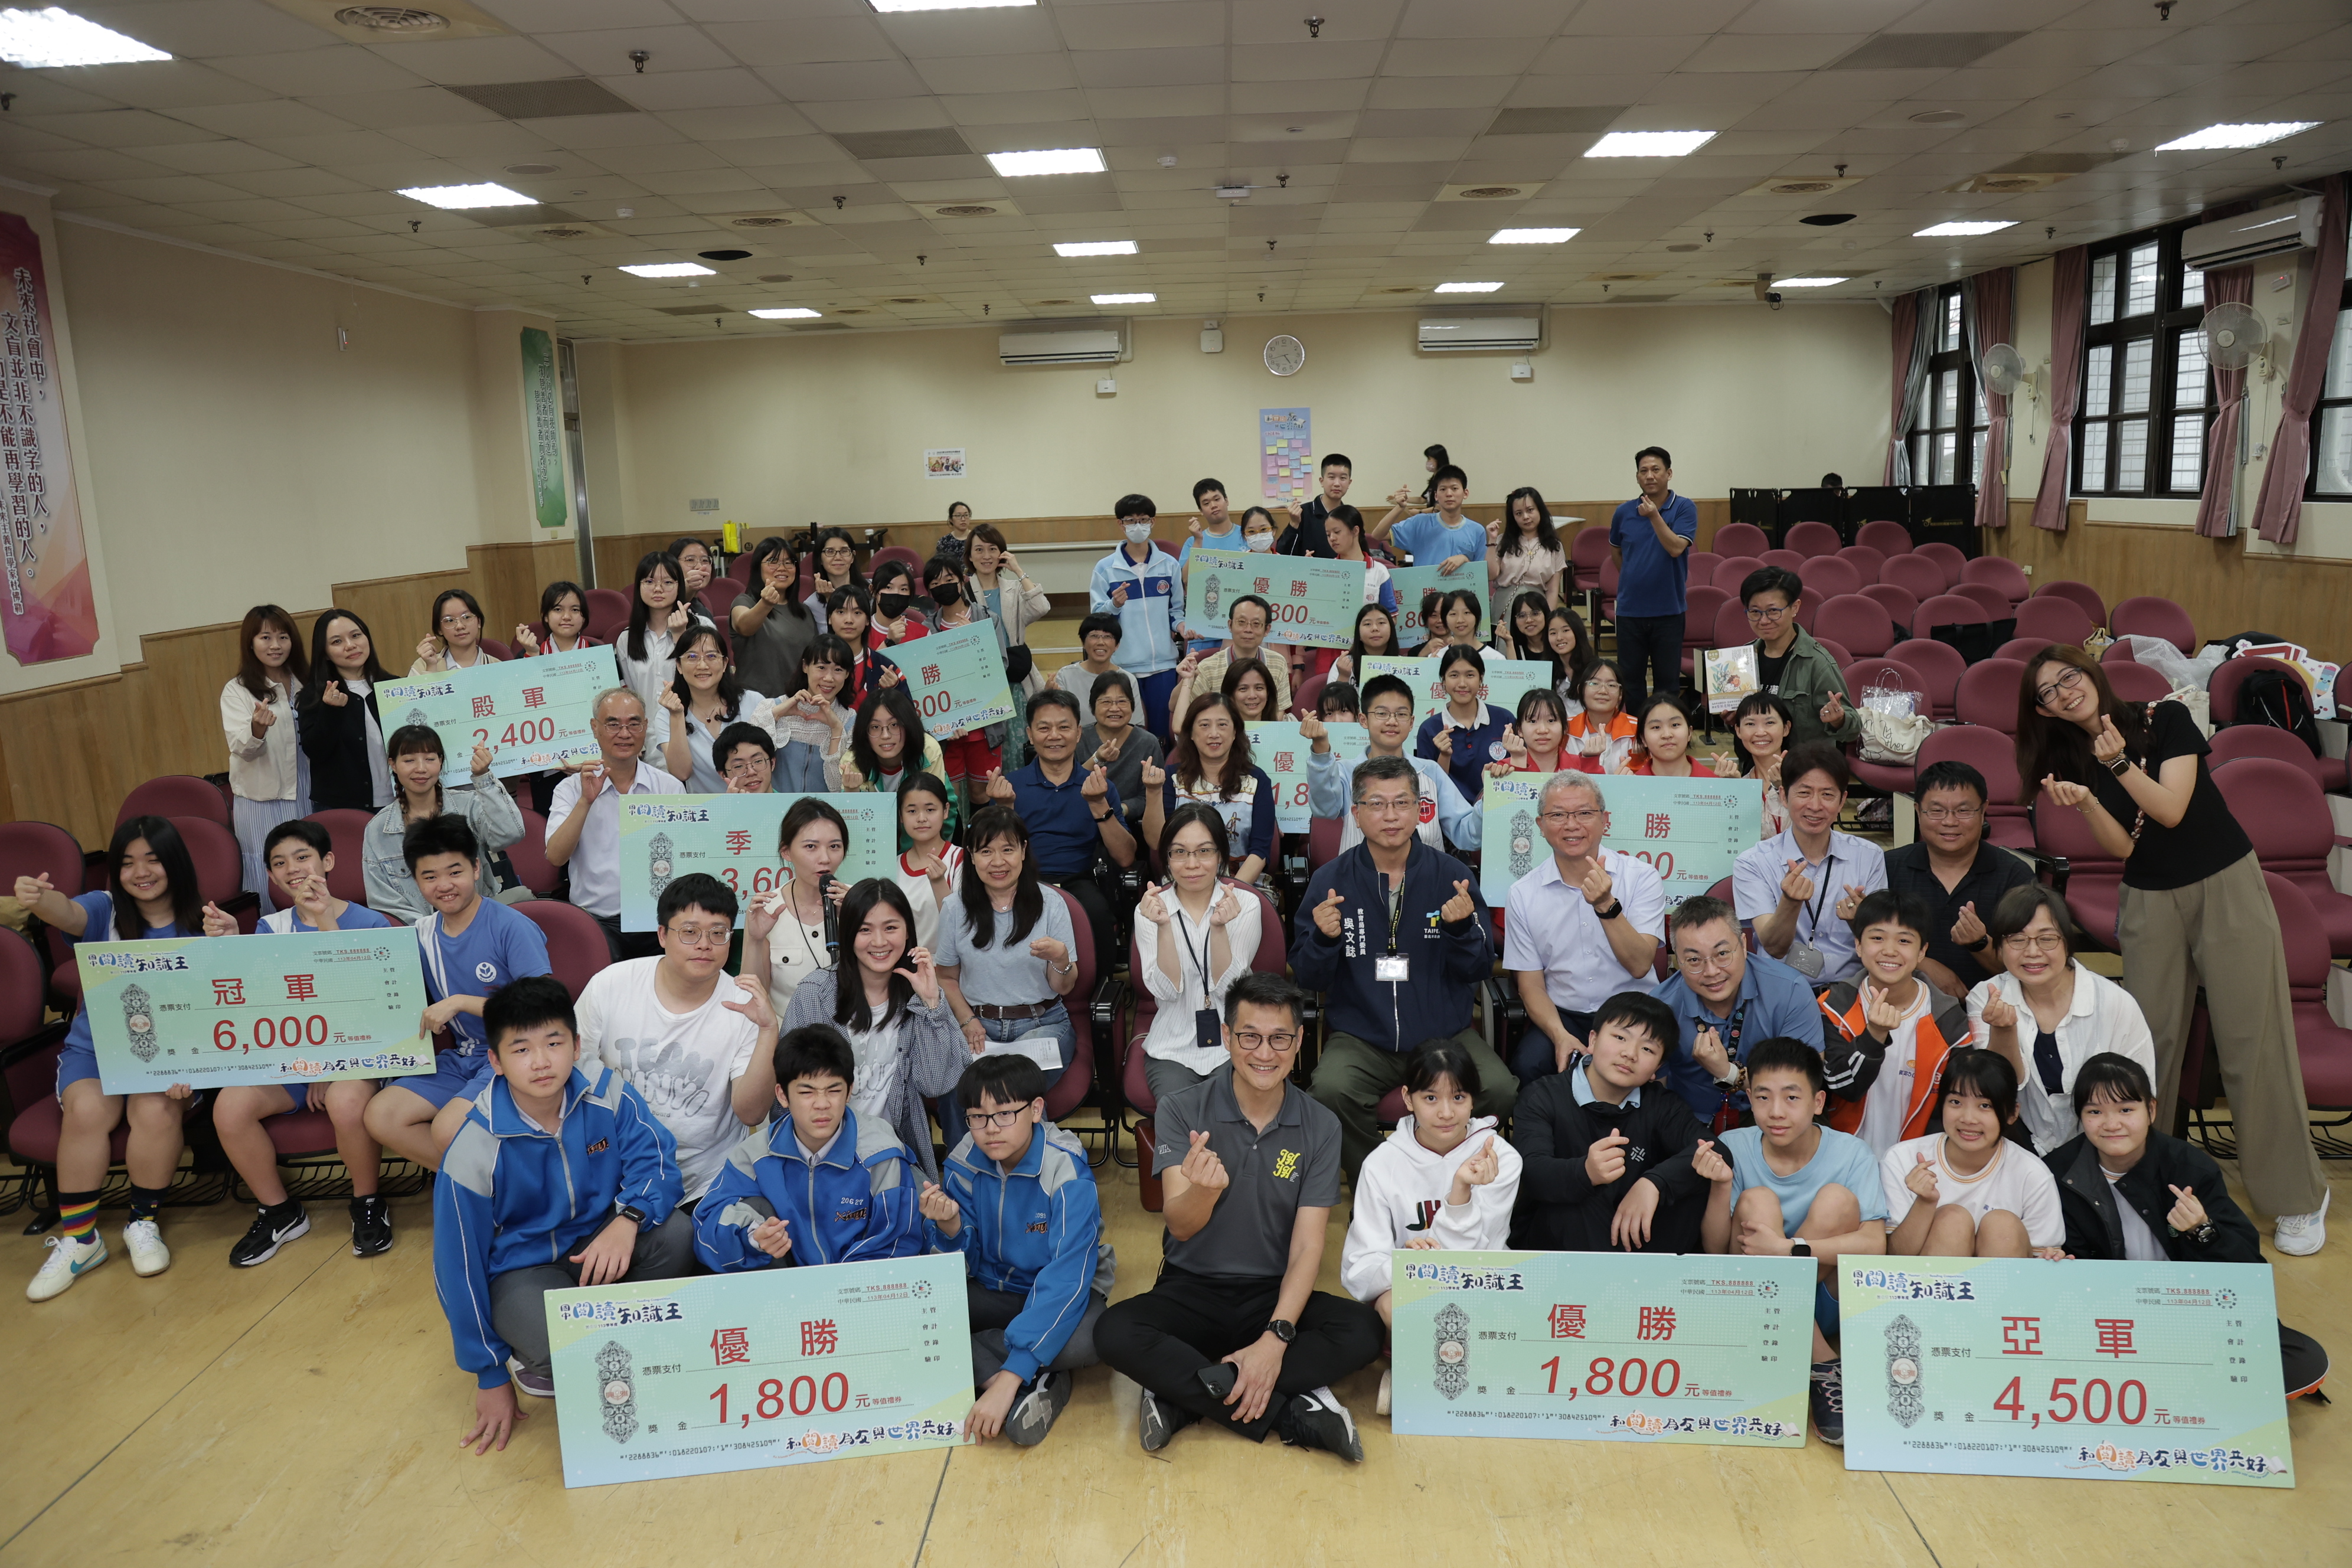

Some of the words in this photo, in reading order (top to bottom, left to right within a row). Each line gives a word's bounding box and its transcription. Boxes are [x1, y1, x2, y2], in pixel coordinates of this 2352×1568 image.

[14, 267, 45, 400] 未來社會中，
[1, 312, 48, 533] 文盲並非不識字的人，
[1253, 576, 1308, 597] 優勝
[1269, 602, 1308, 624] 800
[920, 662, 943, 687] 勝
[390, 678, 455, 704] 閱讀知識王
[470, 686, 547, 718] 殿軍
[953, 699, 962, 708] 元
[469, 717, 557, 757] 2,400
[558, 729, 568, 738] 元
[520, 741, 600, 768] 和閱讀為友與世界
[1272, 782, 1309, 809] 1,8
[1500, 780, 1540, 801] 閱讀知
[636, 803, 710, 823] 閱讀知識王
[726, 829, 752, 855] 季
[720, 867, 793, 900] 3,60
[1676, 870, 1687, 880] 元
[1344, 917, 1357, 958] 吳文誌
[1357, 907, 1366, 955] 教育局專門委員
[211, 973, 319, 1006] 冠軍
[158, 1002, 192, 1012] 憑票支付
[210, 1014, 331, 1056] 6,000
[332, 1032, 347, 1043] 元
[278, 1051, 417, 1076] 和閱讀為友與世界共好
[615, 1038, 714, 1090] TEAM
[837, 1286, 861, 1295] 支票號碼
[865, 1282, 908, 1292] TKS.888888
[1406, 1263, 1415, 1278] 國中
[1417, 1263, 1525, 1291] 閱讀知識王
[1853, 1270, 1863, 1286] 國中
[1864, 1270, 1975, 1301] 閱讀知識王
[837, 1296, 862, 1305] 中華民國
[867, 1291, 909, 1301] 113年04月12日
[920, 1306, 936, 1315] 主管
[2135, 1297, 2161, 1305] 中華民國
[2166, 1298, 2212, 1306] 113年04月12日
[560, 1304, 571, 1320] 國中
[571, 1293, 684, 1330] 閱讀知識王
[1547, 1302, 1678, 1342] 優勝
[2225, 1319, 2243, 1328] 主管
[922, 1322, 938, 1331] 會計
[1478, 1331, 1517, 1341] 憑票支付
[2000, 1316, 2138, 1358] 亞軍
[708, 1316, 841, 1366] 優勝
[923, 1339, 939, 1347] 登錄
[1930, 1346, 1971, 1358] 憑票支付
[2227, 1337, 2245, 1346] 會計
[642, 1363, 682, 1377] 憑票支付
[925, 1355, 941, 1364] 驗印
[2229, 1355, 2246, 1364] 登錄
[1477, 1385, 1516, 1396] 獎金
[1538, 1355, 1680, 1404] 1,800
[1684, 1383, 1700, 1397] 元
[1701, 1389, 1733, 1397] 等值禮券
[2230, 1374, 2248, 1383] 驗印
[707, 1371, 851, 1432] 1,800
[854, 1393, 871, 1409] 元
[871, 1395, 902, 1406] 等值禮券
[1991, 1375, 2150, 1433] 4,500
[2153, 1408, 2171, 1425] 元
[2172, 1415, 2206, 1425] 等值禮券
[648, 1420, 688, 1434] 獎金
[1609, 1411, 1784, 1438] 和閱讀為友與世界共好
[1933, 1410, 1975, 1423] 獎金
[784, 1416, 956, 1455] 和閱讀為友與世界共好
[2077, 1442, 2268, 1475] 和閱讀為友與世界共好
